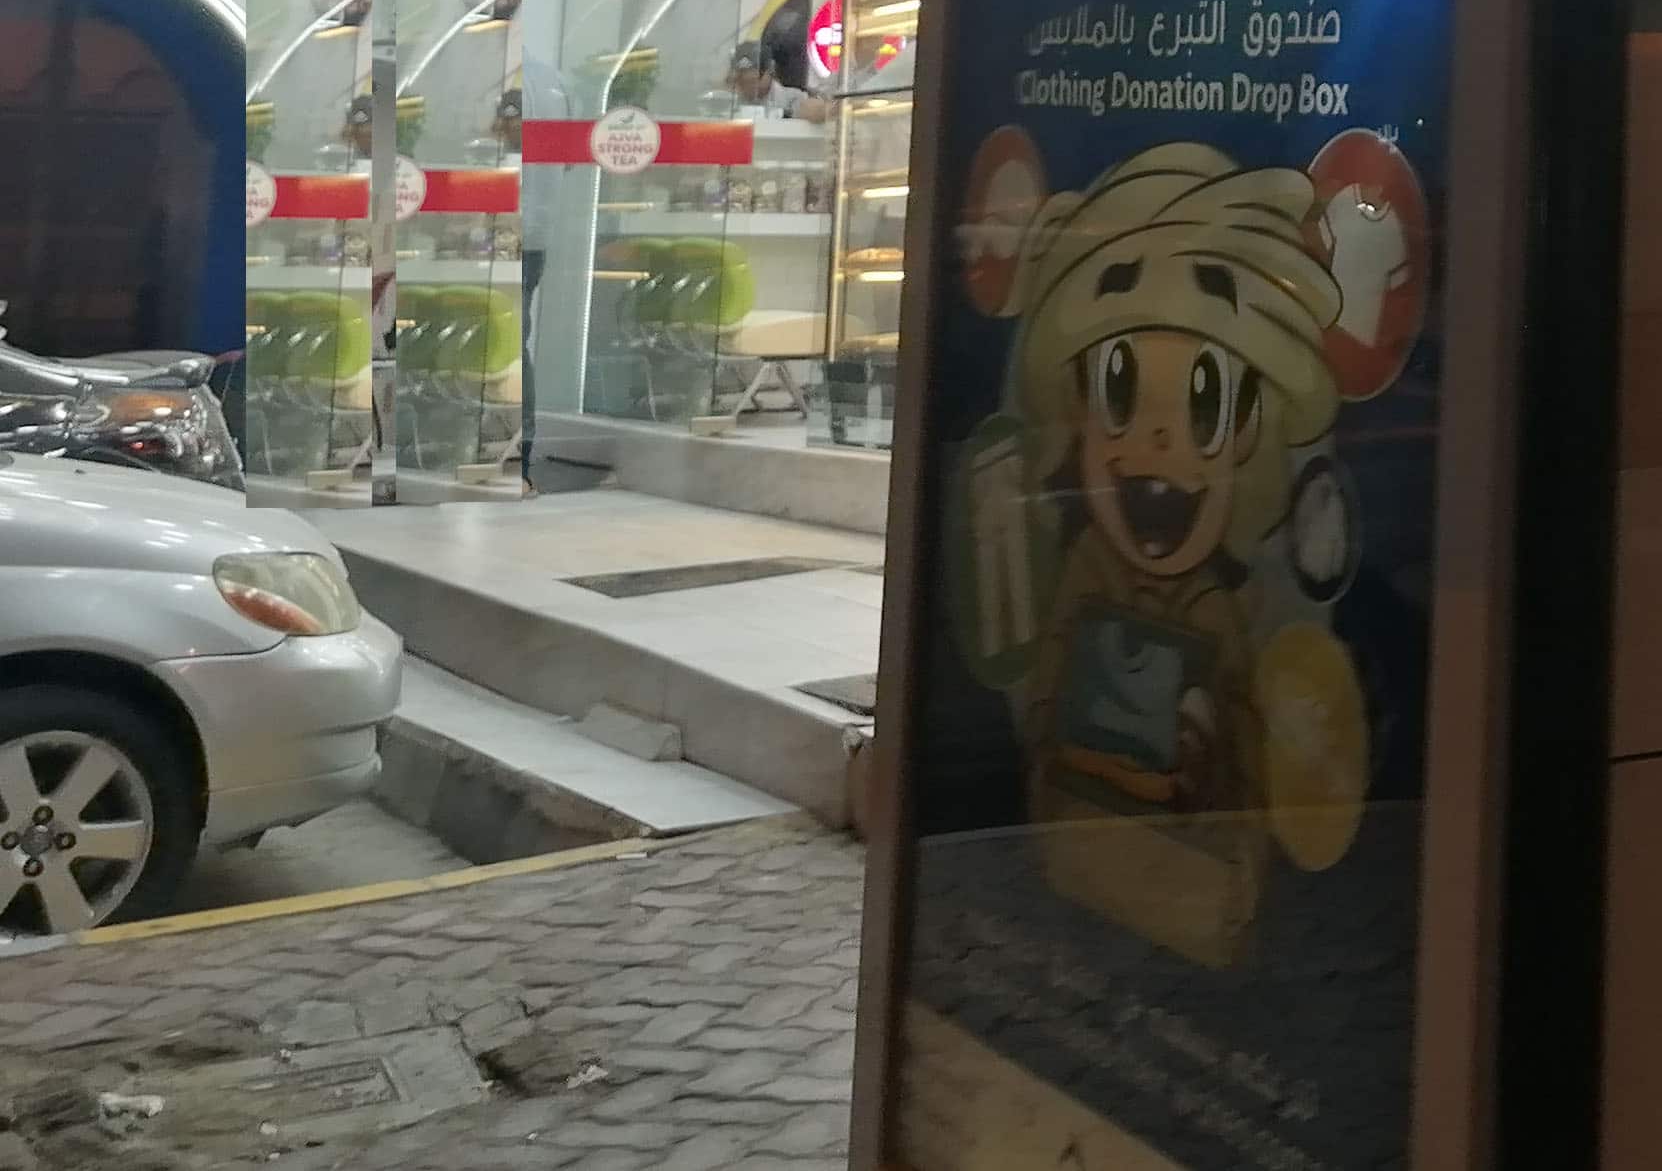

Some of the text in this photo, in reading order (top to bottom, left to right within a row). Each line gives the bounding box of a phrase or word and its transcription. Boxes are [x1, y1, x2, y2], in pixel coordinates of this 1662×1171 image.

[1148, 0, 1227, 58] التبرع
[1019, 69, 1350, 123] Clothing Donation Drop Box
[597, 142, 654, 154] STRONG
[611, 154, 638, 165] TEA
